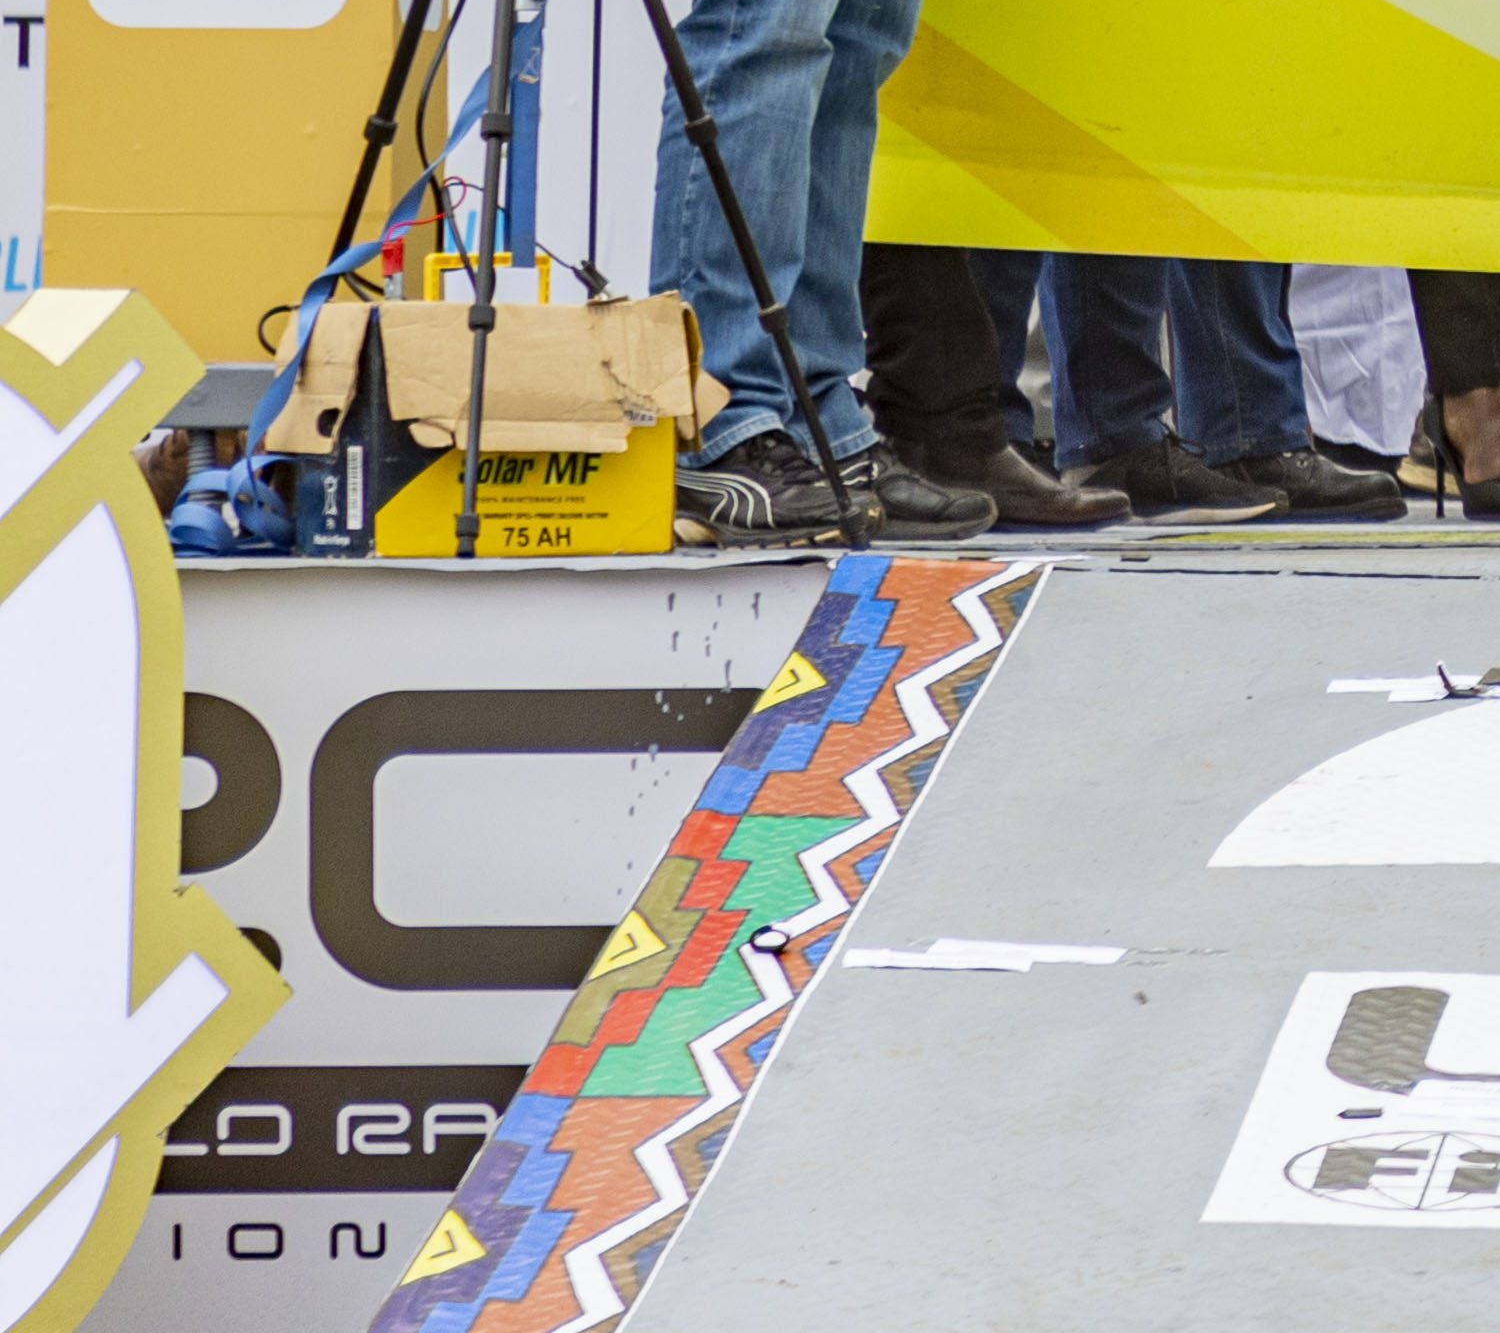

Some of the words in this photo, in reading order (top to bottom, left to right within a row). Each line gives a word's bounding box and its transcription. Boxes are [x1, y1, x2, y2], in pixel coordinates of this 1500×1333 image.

[540, 452, 602, 484] MF
[504, 527, 529, 547] 75
[537, 527, 570, 546] AH
